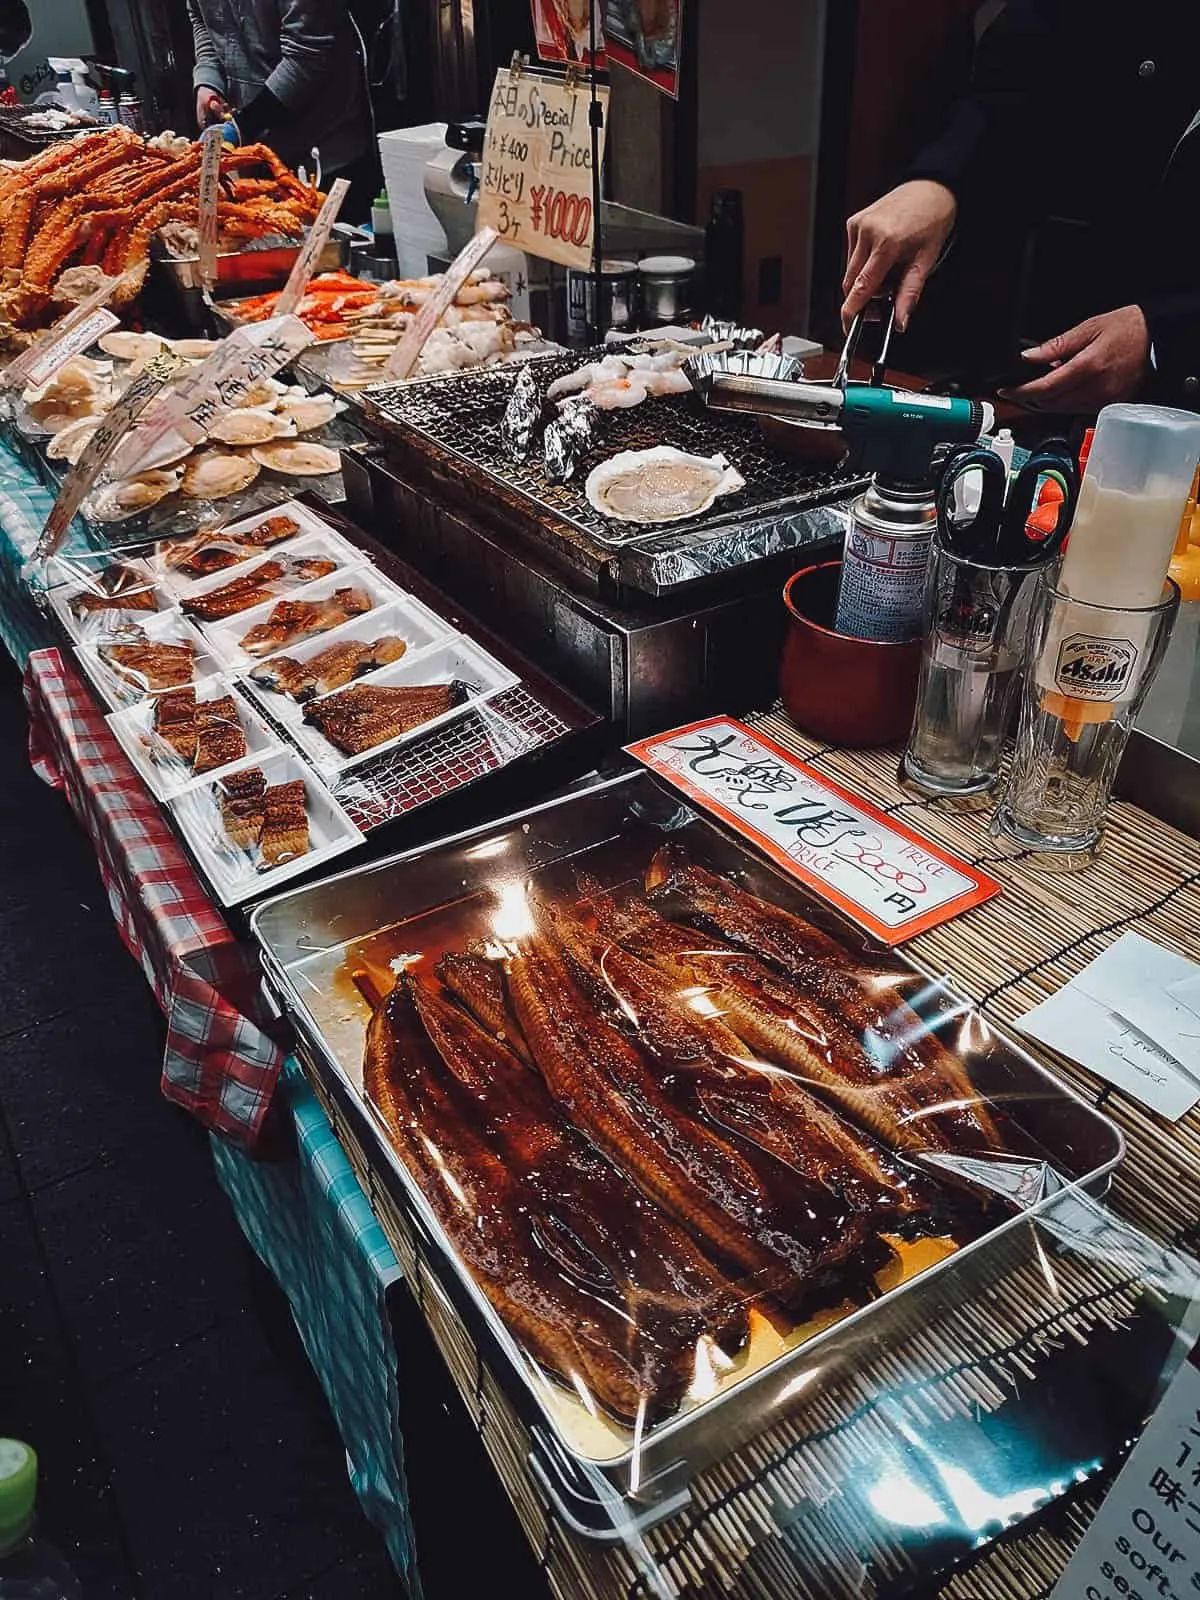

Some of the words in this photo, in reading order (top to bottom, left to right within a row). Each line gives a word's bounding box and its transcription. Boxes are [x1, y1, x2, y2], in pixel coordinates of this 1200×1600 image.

[499, 134, 529, 162] ¥400
[549, 131, 592, 169] Price
[529, 184, 591, 247] ¥1000
[1060, 656, 1130, 683] Asahi
[787, 839, 840, 872] PRICE
[899, 844, 948, 878] PRICE
[883, 892, 917, 914] 円
[1131, 1508, 1187, 1563] Our
